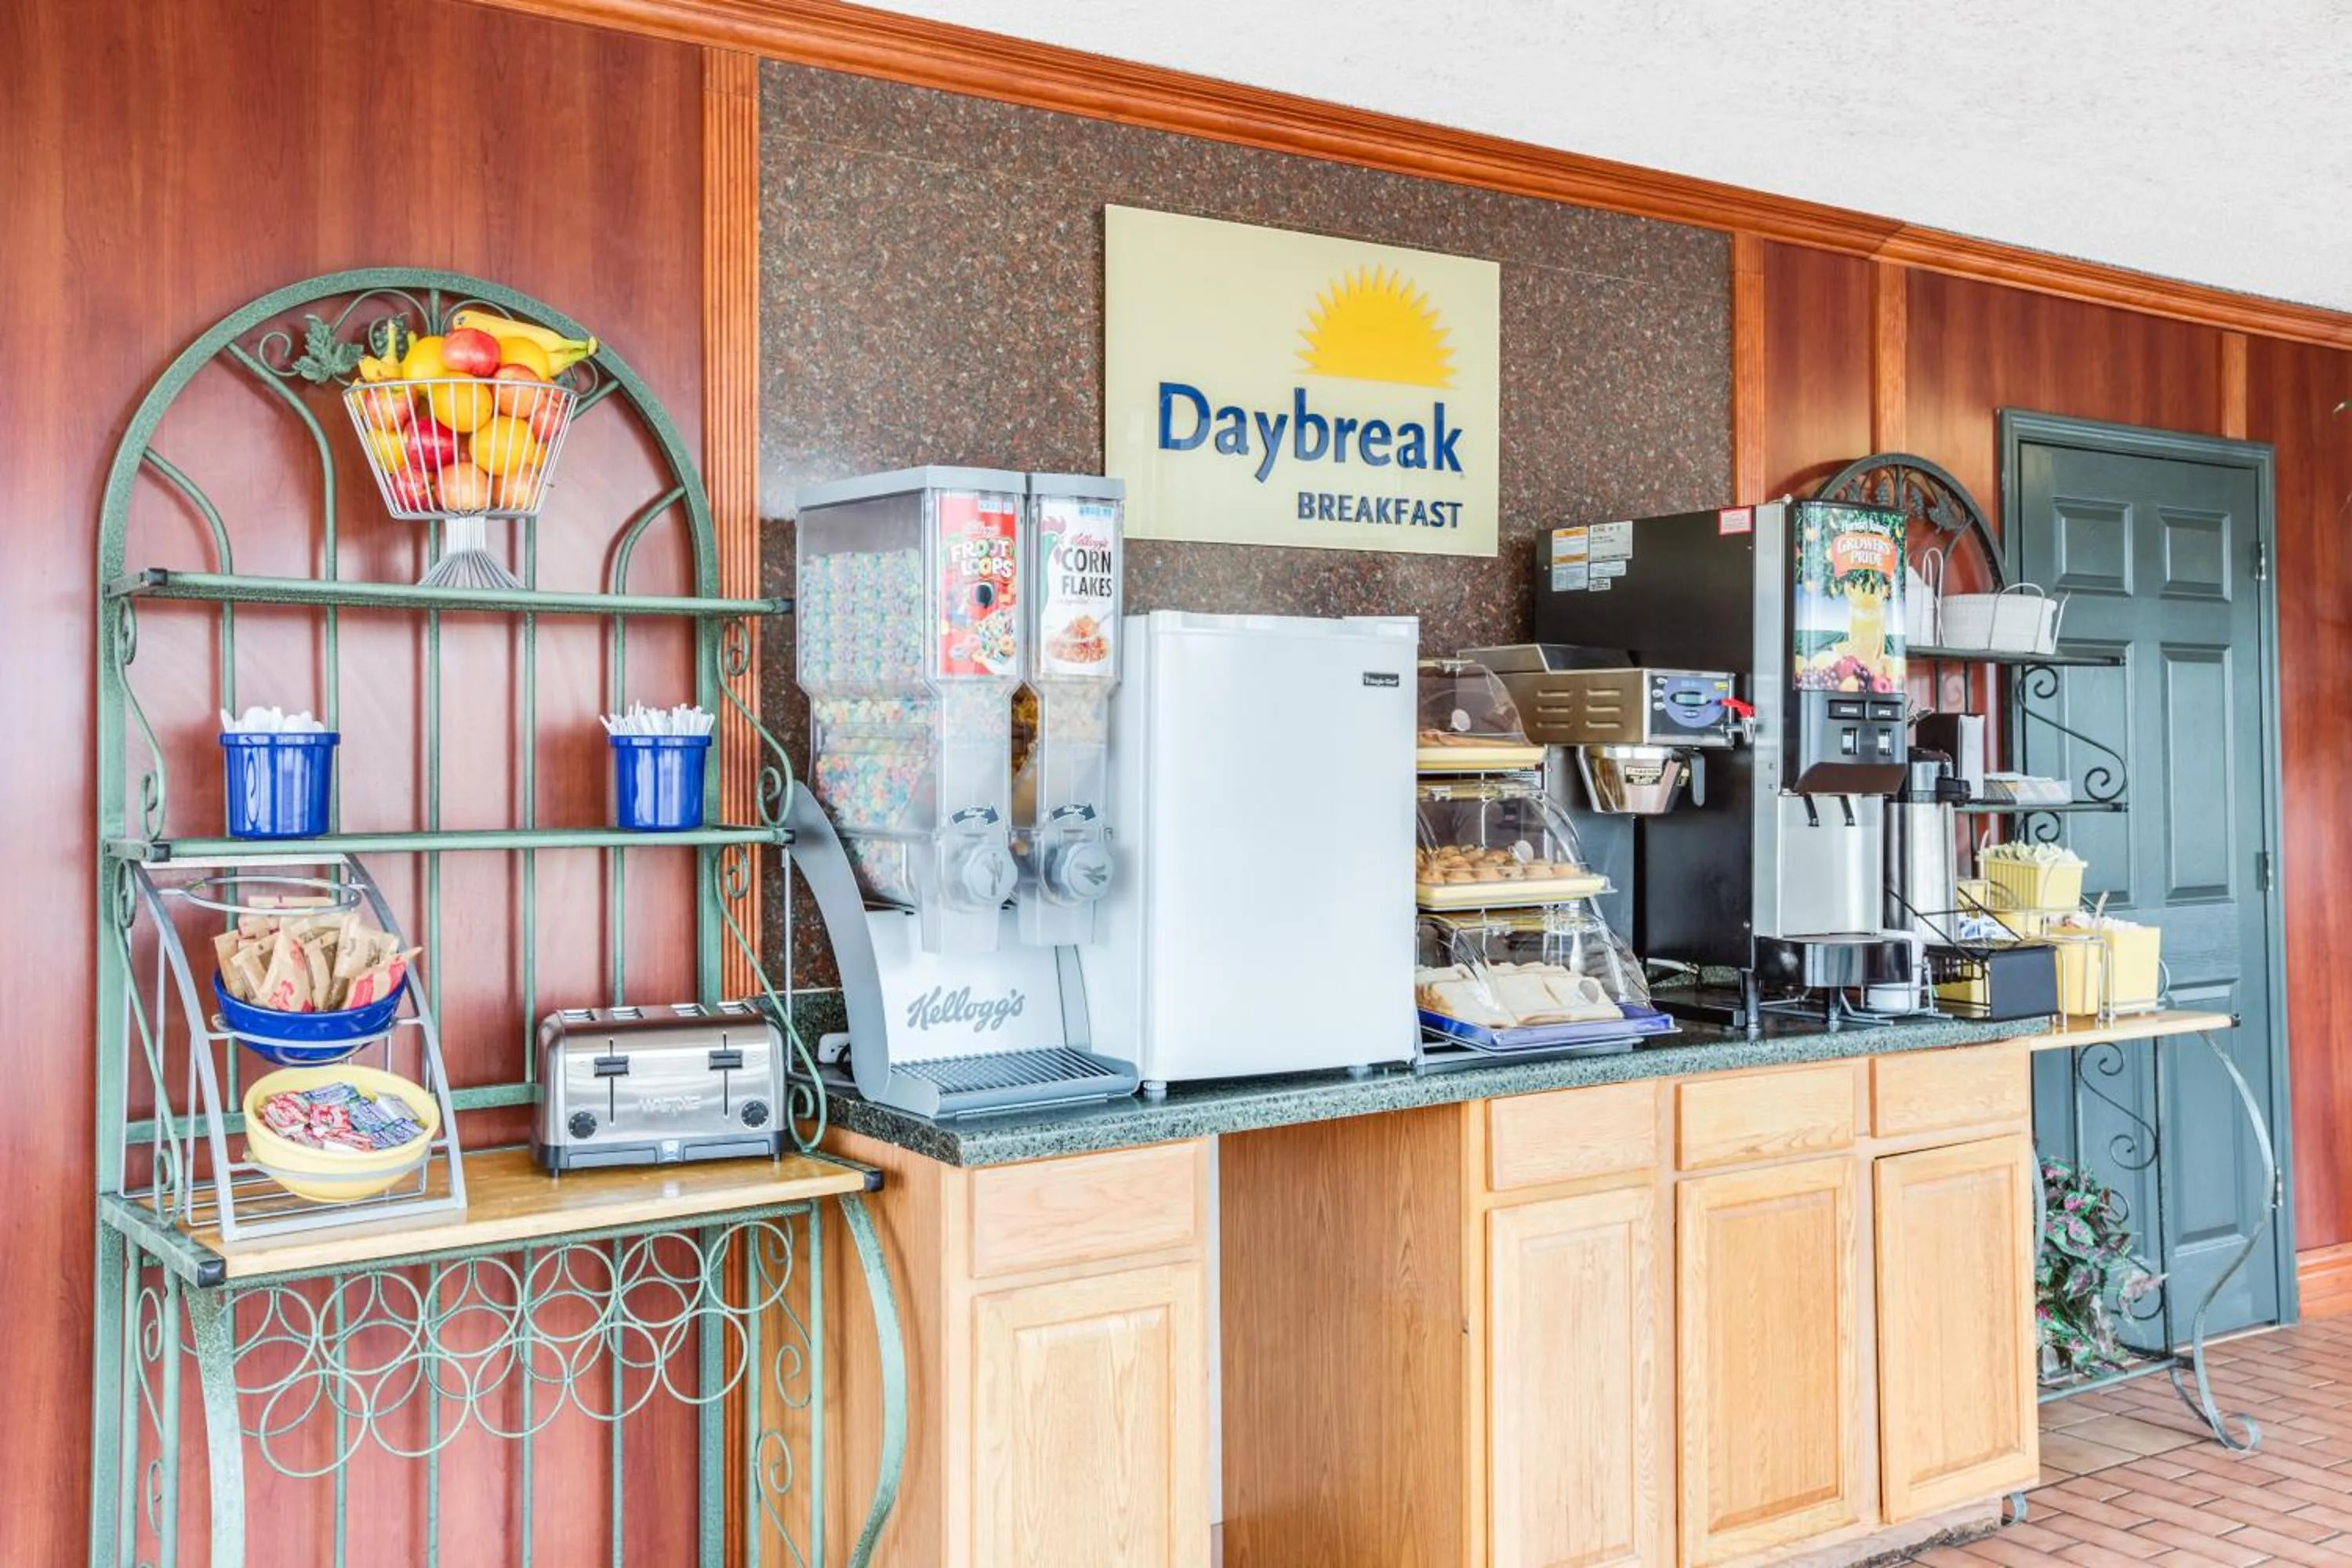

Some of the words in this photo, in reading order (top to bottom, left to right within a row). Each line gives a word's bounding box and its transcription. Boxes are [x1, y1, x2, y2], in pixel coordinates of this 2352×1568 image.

[1159, 382, 1465, 485] Daybreak
[1298, 491, 1464, 528] BREAKFAST
[960, 557, 1013, 578] LOOPS
[1061, 546, 1112, 574] CORN
[1061, 575, 1112, 597] FLAKES
[906, 985, 1025, 1033] Kellogg's
